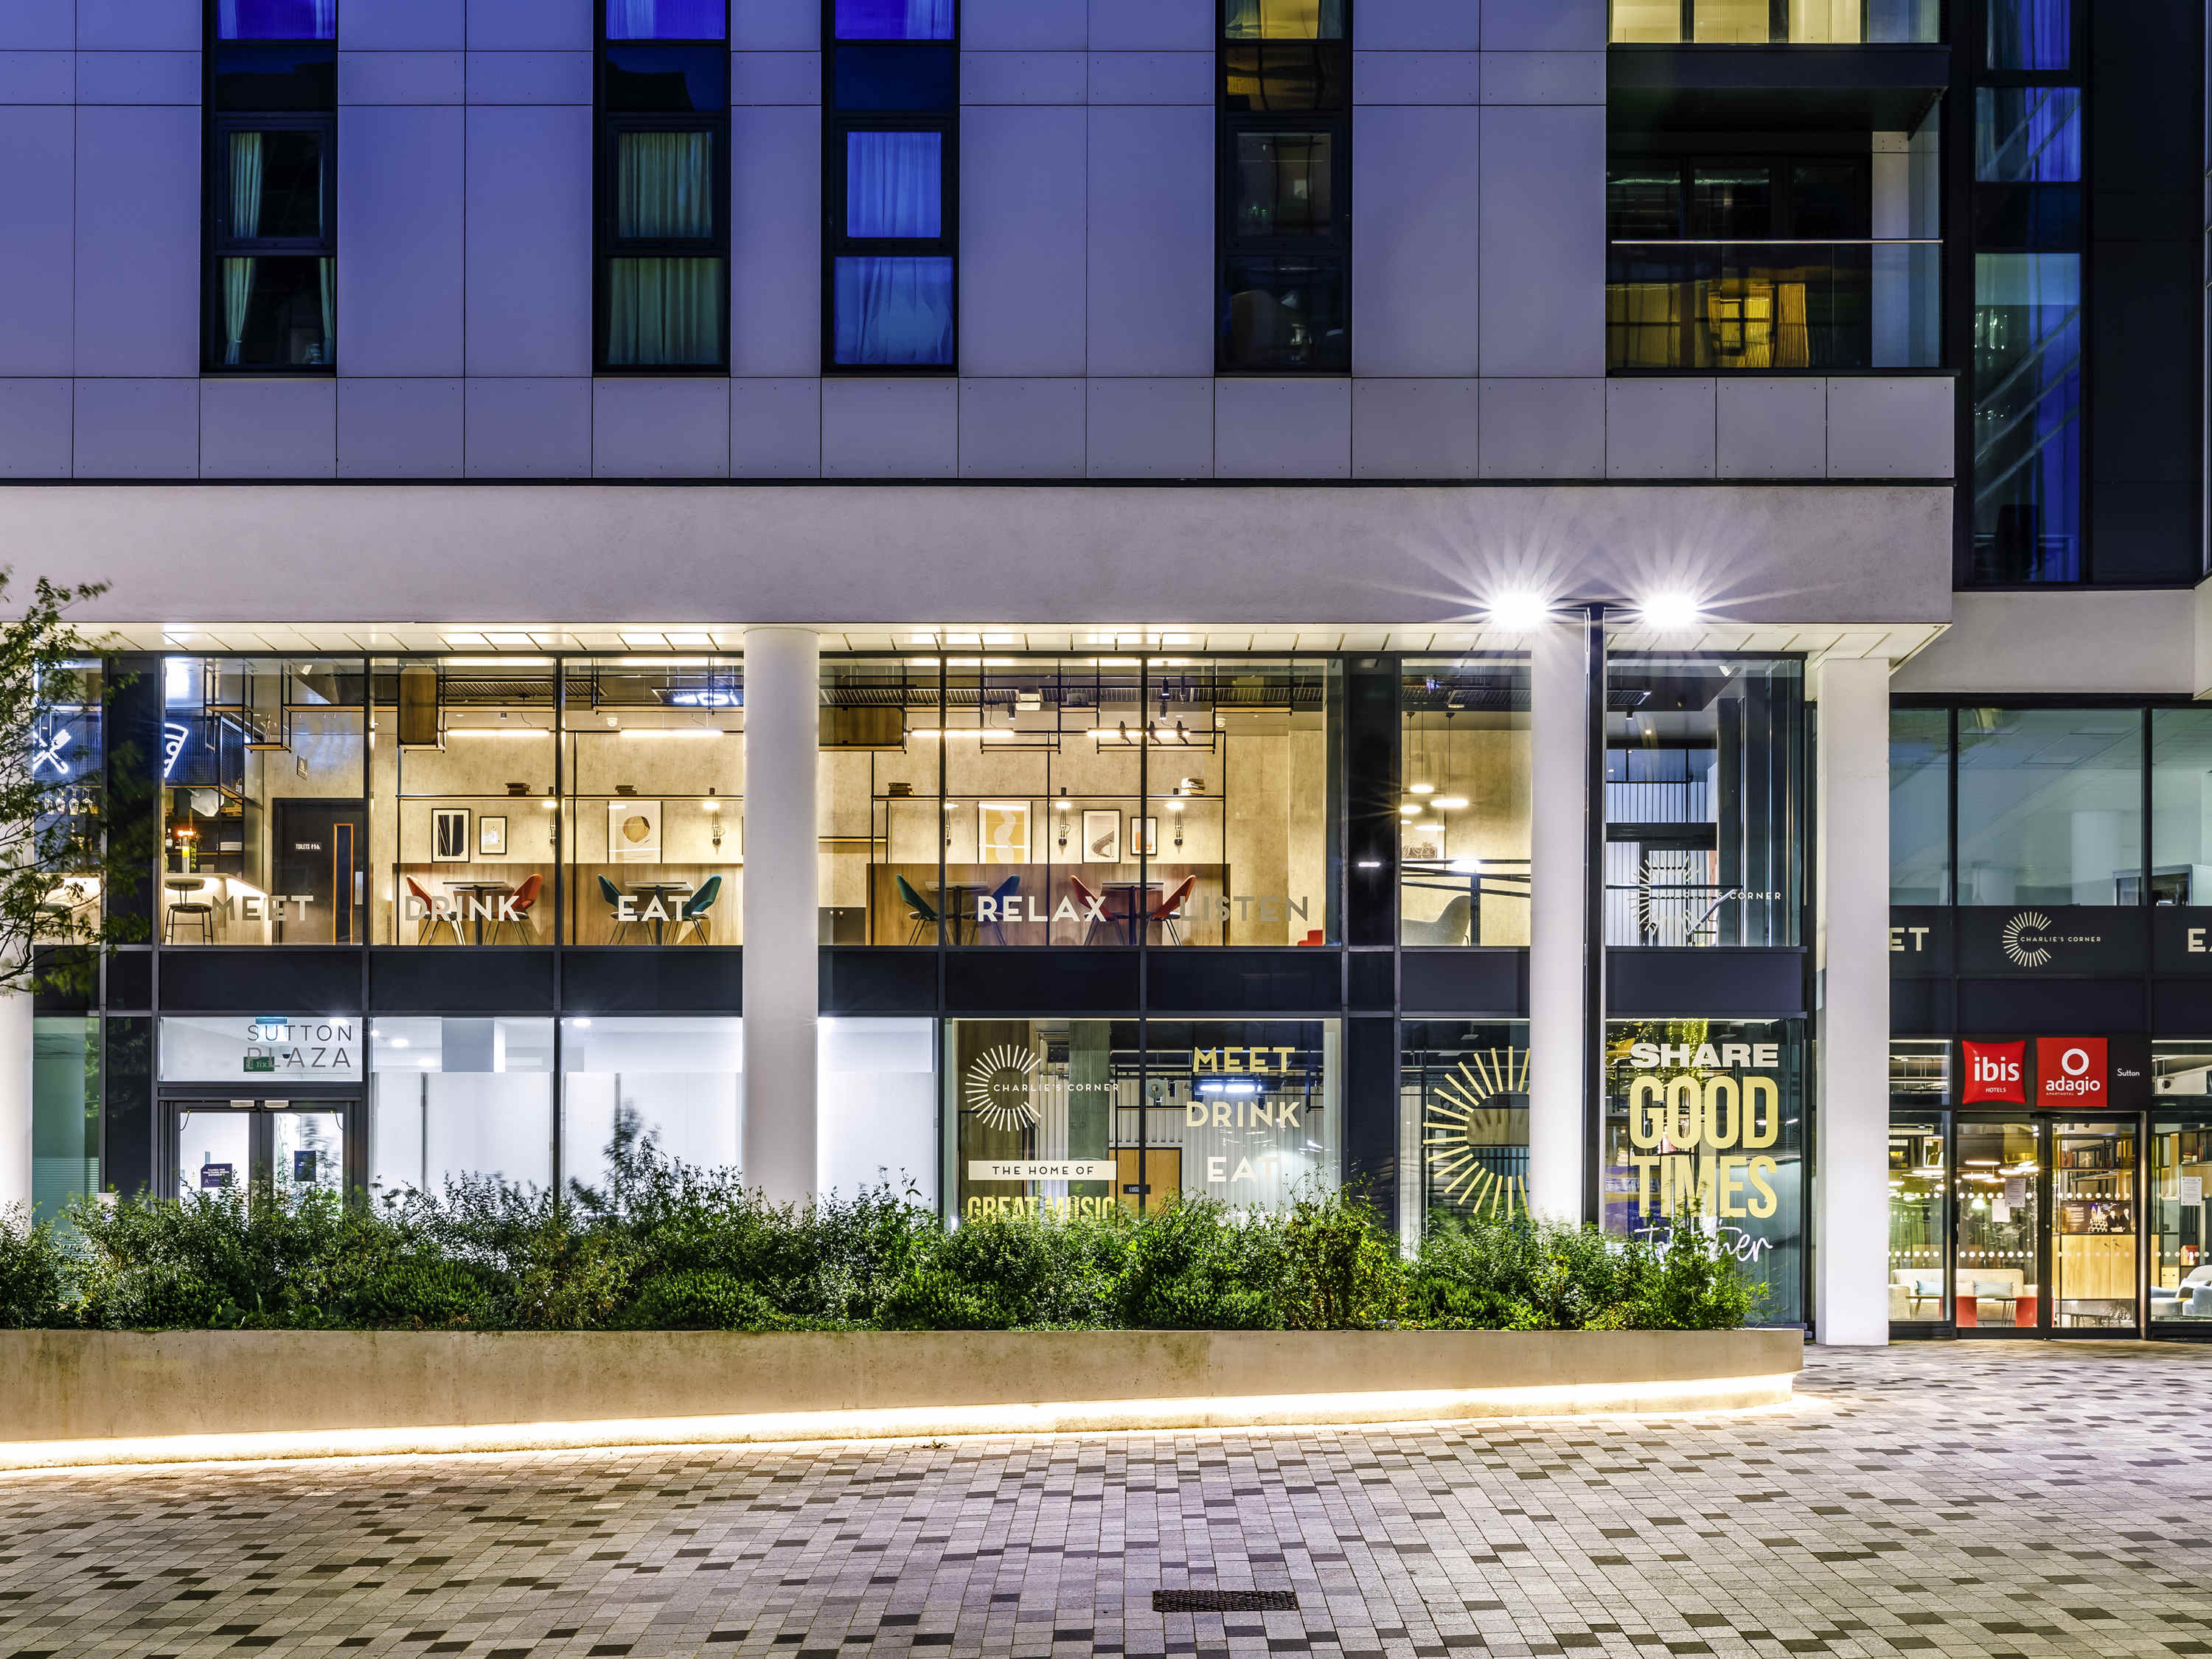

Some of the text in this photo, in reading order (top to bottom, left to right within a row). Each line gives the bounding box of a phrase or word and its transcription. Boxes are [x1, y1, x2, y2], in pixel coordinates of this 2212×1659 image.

[211, 895, 314, 921] MEET
[1730, 891, 1781, 900] CORNER
[405, 895, 521, 922] DRINK
[618, 895, 690, 922] EAT
[977, 895, 1107, 922] RELAX
[1180, 896, 1309, 922] LISTEN
[1889, 927, 1929, 951] ET
[2188, 928, 2212, 952] E
[247, 1025, 352, 1041] SUTTON
[247, 1047, 351, 1068] PLAZA
[1193, 1046, 1295, 1073] MEET
[1630, 1043, 1778, 1068] SHARE
[1974, 1057, 2020, 1082] ibis
[2117, 1068, 2140, 1077] Sutton
[993, 1084, 1119, 1092] CHARLIE'S CORNER
[2045, 1076, 2101, 1096] adagio
[1186, 1102, 1301, 1127] DRINK
[1630, 1075, 1778, 1149] GOOD
[992, 1166, 1095, 1175] THE HOME OF
[1207, 1156, 1281, 1183] EAT
[1630, 1155, 1778, 1219] TIMES
[967, 1196, 1039, 1224] GREAT
